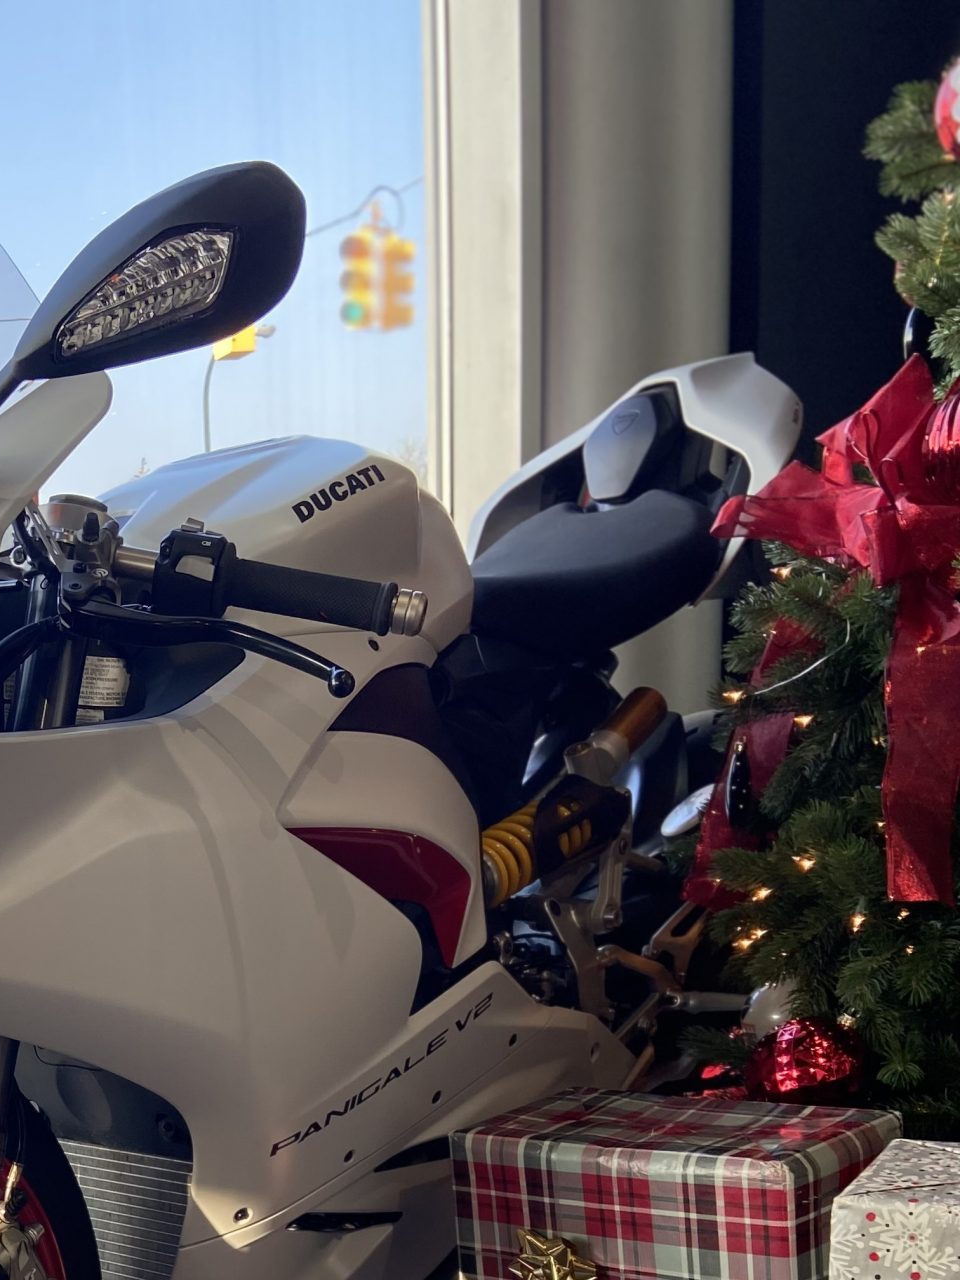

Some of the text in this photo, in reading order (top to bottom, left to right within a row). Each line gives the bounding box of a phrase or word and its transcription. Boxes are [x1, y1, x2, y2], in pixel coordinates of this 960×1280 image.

[292, 464, 385, 523] DUCATI
[270, 992, 494, 1157] PANIGALE V2
